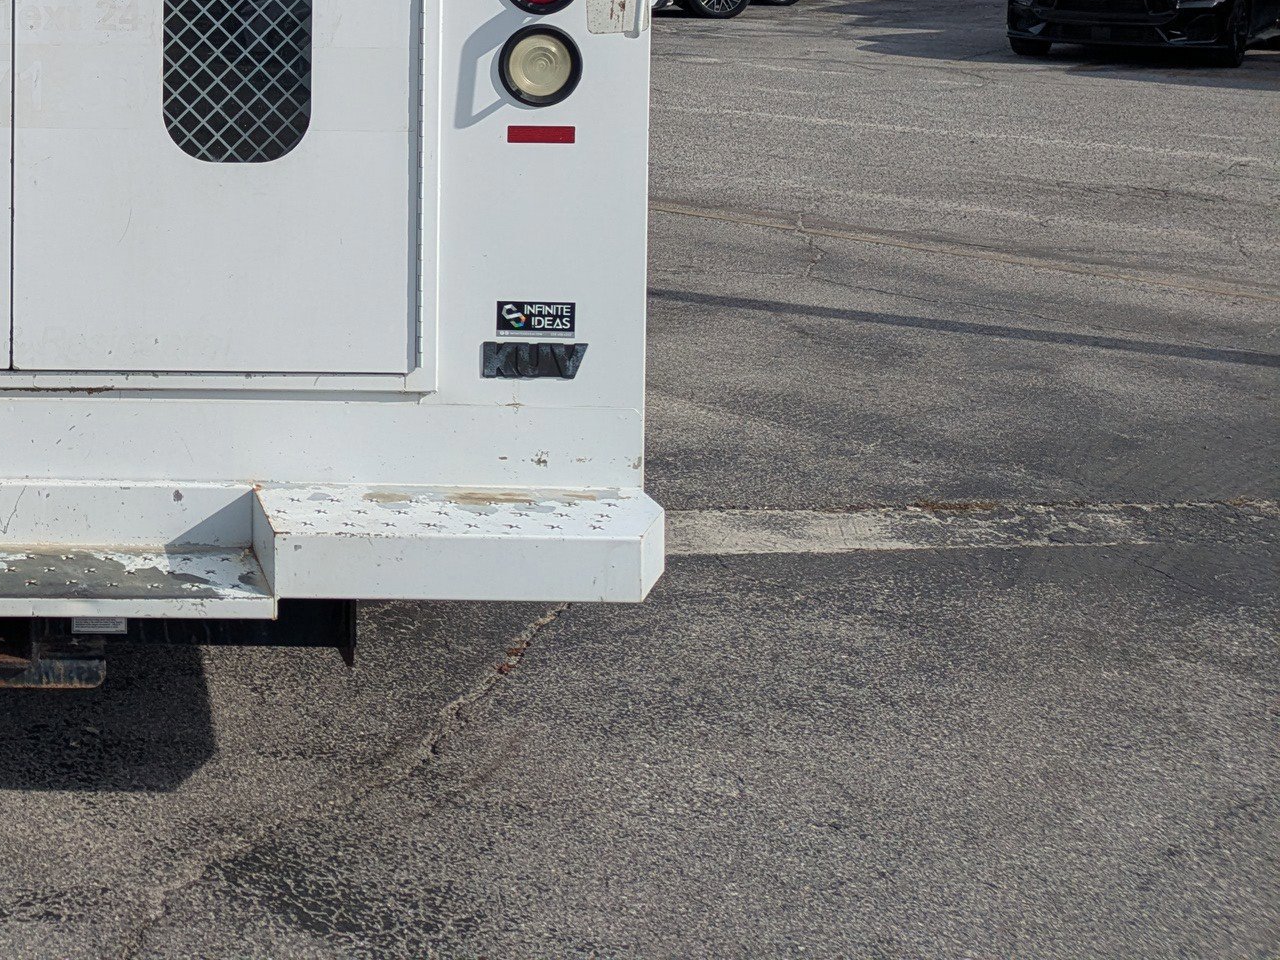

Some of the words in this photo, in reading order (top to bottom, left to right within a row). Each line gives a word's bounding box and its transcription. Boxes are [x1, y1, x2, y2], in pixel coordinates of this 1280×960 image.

[524, 304, 571, 316] INFINITE
[531, 316, 571, 329] IDEAS
[482, 341, 589, 380] KUV
